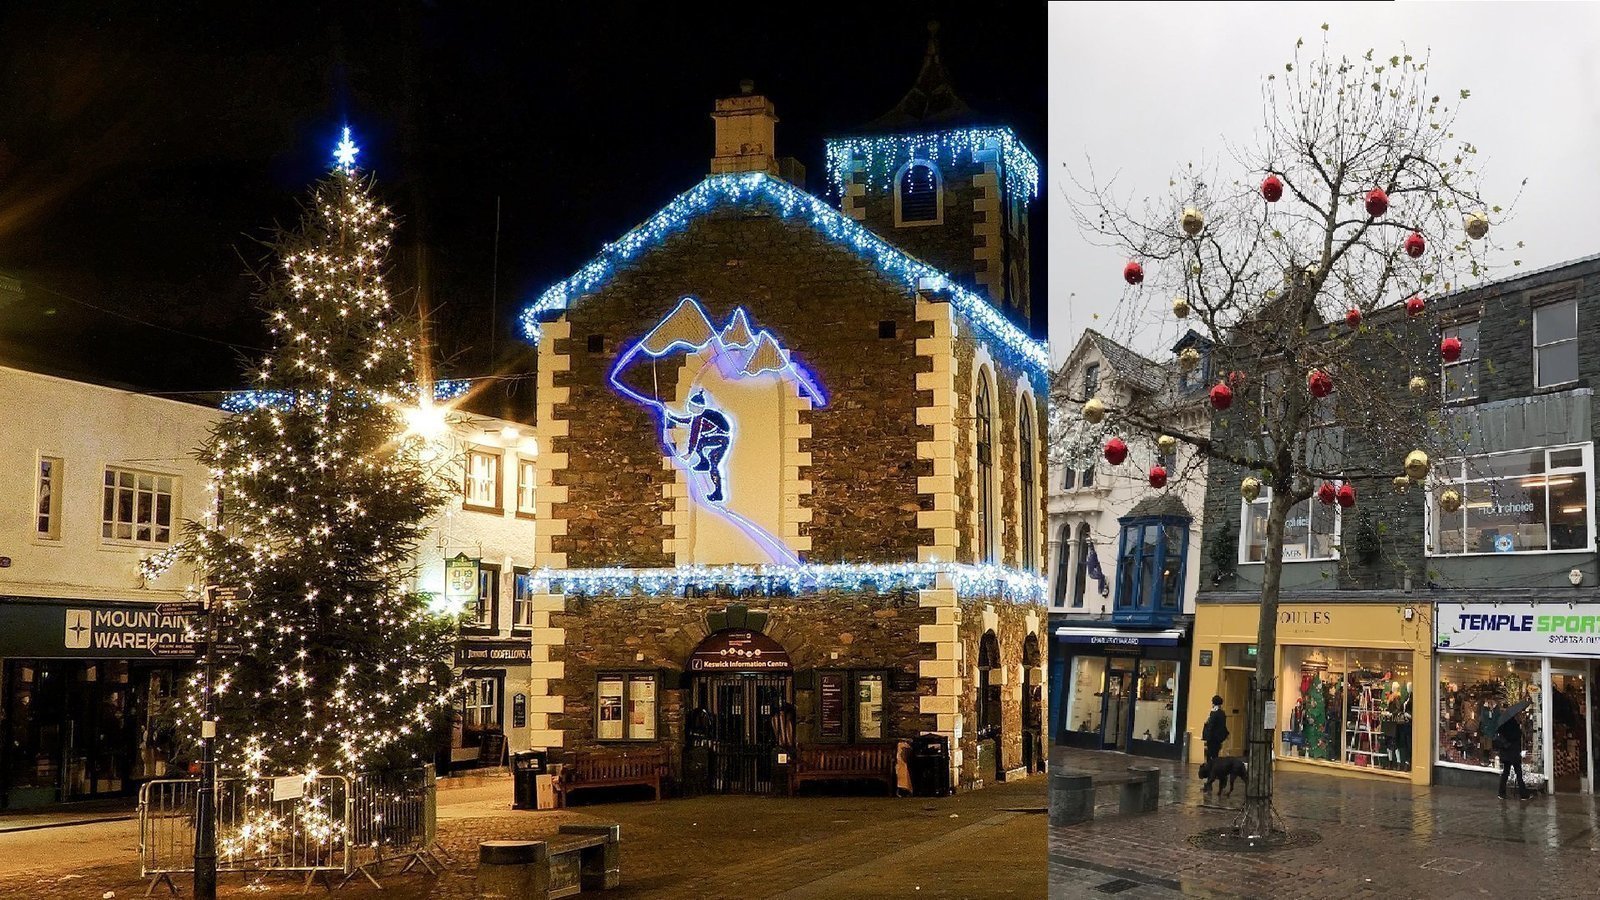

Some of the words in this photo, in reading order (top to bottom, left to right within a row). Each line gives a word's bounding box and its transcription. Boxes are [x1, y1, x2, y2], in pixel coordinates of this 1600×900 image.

[95, 611, 189, 629] MOUNTAIN
[1277, 611, 1332, 625] OULES
[1458, 614, 1534, 632] TEMPLE
[1536, 615, 1600, 633] SPOR
[703, 660, 729, 668] Keswick
[730, 660, 767, 668] Information
[767, 660, 788, 668] Centre
